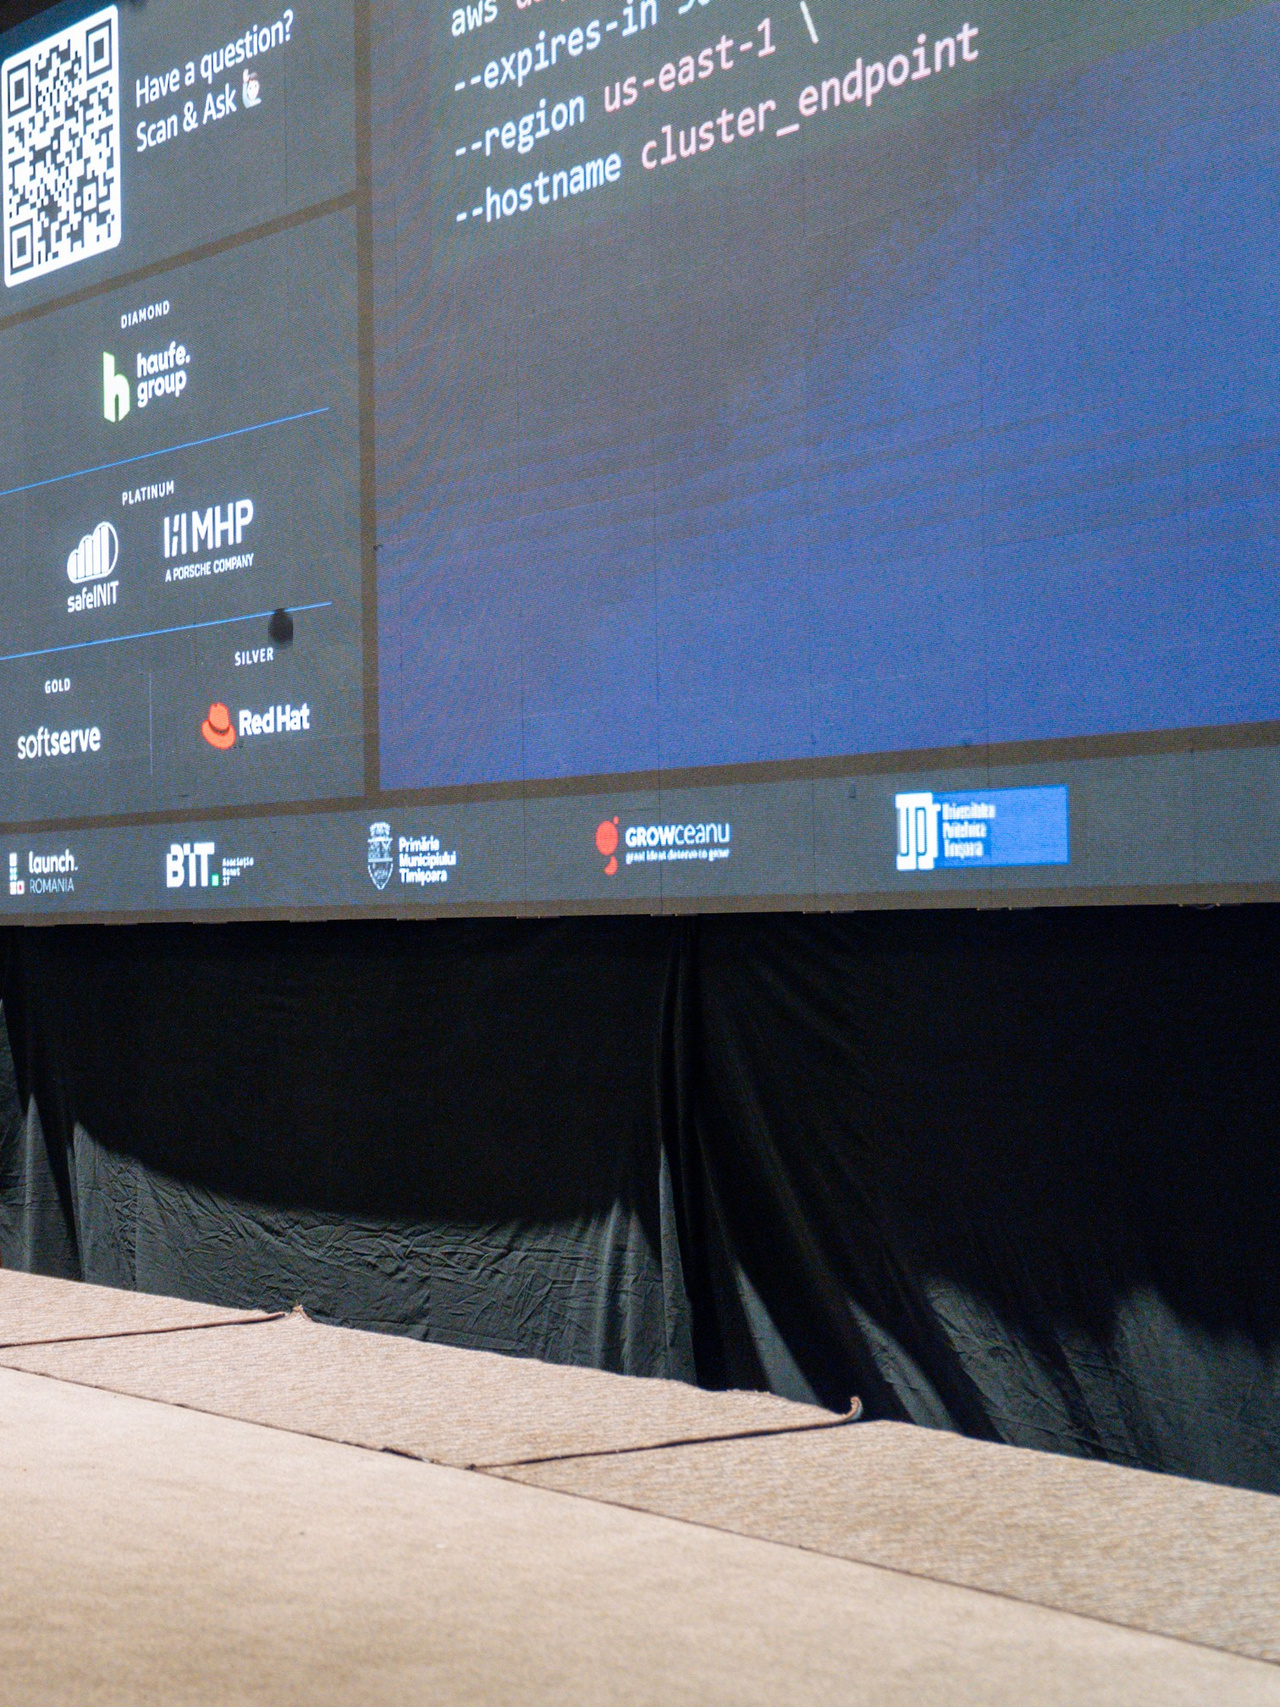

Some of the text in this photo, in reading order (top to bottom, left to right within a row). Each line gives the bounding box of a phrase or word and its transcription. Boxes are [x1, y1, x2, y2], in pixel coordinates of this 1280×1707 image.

[451, 0, 499, 37] aws
[135, 9, 294, 108] Have a question?
[454, 0, 658, 92] --expires-in
[455, 95, 586, 157] --region
[604, 17, 777, 112] us-east-1
[136, 83, 237, 152] Scan & Ask
[456, 23, 980, 223] --hostname cluster_endpoint
[120, 300, 170, 329] DIAMOND
[136, 370, 188, 408] group
[122, 480, 175, 506] PLATINUM
[191, 498, 254, 553] MHP
[165, 552, 255, 582] A PORSCHE COMPANY
[67, 580, 119, 613] safeINIT
[234, 647, 274, 667] SILVER
[44, 677, 71, 694] GOLD
[238, 703, 310, 736] Red Hat
[17, 726, 101, 760] softserve
[625, 822, 730, 848] GROWceanu
[29, 877, 75, 894] ROMANIA
